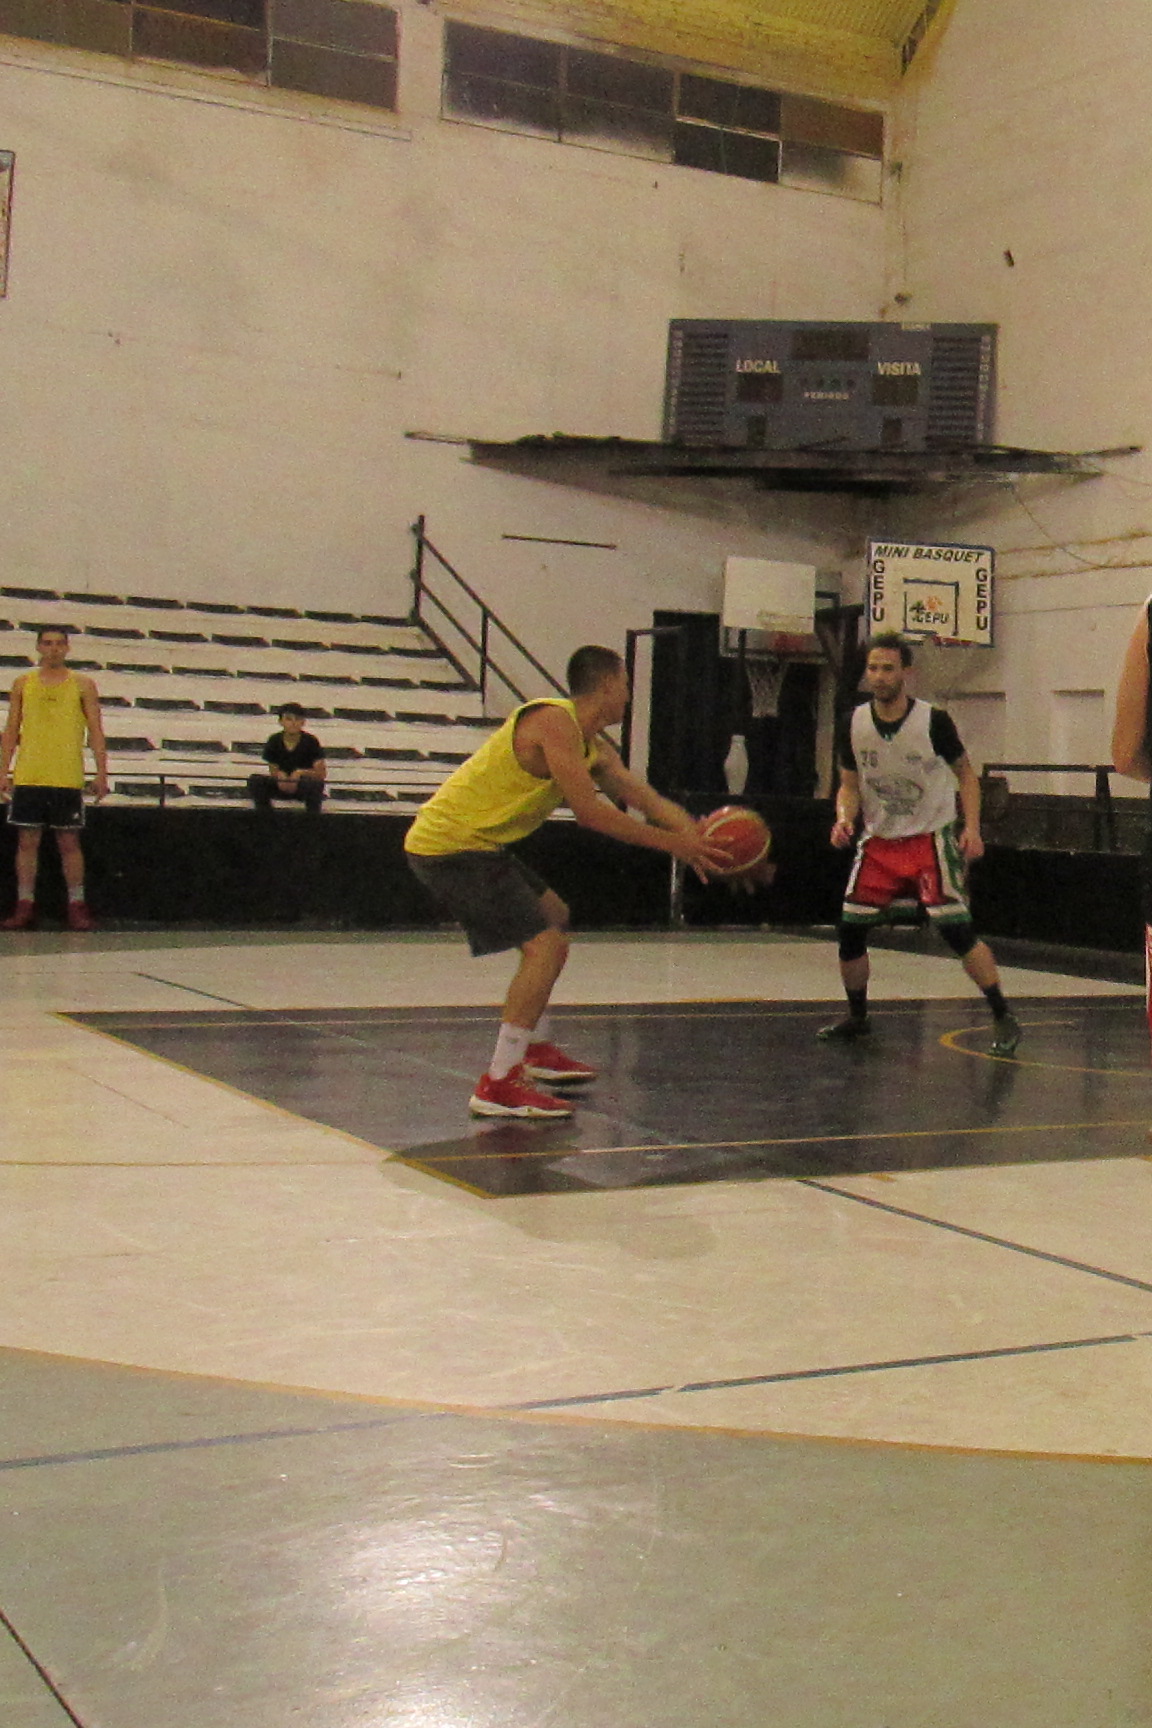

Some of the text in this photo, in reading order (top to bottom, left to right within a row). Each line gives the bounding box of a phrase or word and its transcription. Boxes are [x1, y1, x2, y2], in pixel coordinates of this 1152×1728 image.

[735, 359, 781, 374] LOCAL
[878, 361, 922, 376] VISITA
[874, 545, 984, 563] MINI BASQUET
[872, 559, 885, 622] GEPU
[976, 567, 988, 631] GEPU
